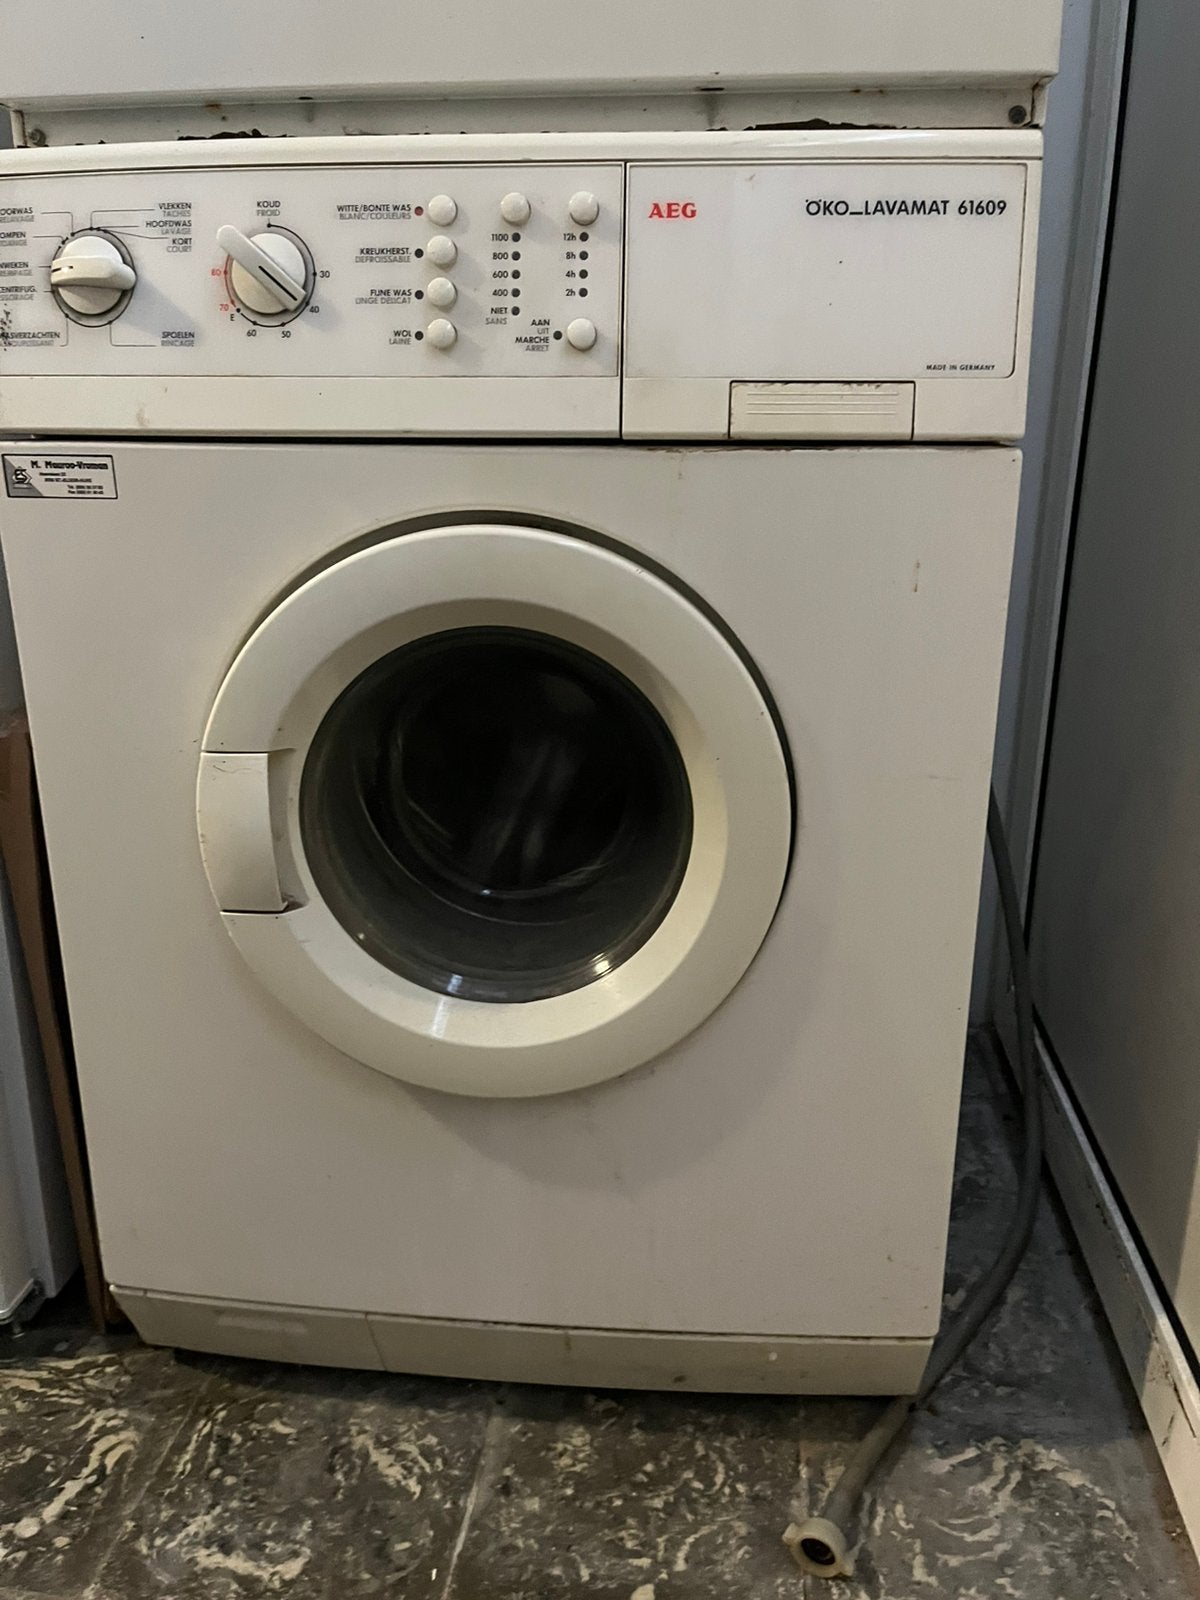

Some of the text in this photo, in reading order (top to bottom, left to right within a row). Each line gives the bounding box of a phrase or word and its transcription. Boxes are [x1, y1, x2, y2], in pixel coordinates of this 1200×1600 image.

[159, 202, 192, 210] VLEKKEN
[256, 200, 281, 208] KOUD
[336, 204, 411, 212] WITTE/BONTE WAS
[957, 199, 1007, 216] 61609
[0, 207, 33, 216] OORWAS
[256, 209, 280, 217] FROID
[648, 202, 697, 219] AEG
[339, 212, 411, 220] BLANC/COULEURS
[145, 220, 192, 228] HOOFDWAS
[491, 233, 509, 242] 1100
[563, 233, 577, 241] 12h
[172, 238, 192, 246] KORT
[492, 251, 509, 260] 800
[565, 251, 577, 260] 8h
[319, 270, 330, 278] 30
[492, 270, 509, 279] 600
[565, 270, 576, 278] 4h
[392, 288, 412, 297] WAS
[492, 288, 509, 297] 400
[565, 288, 576, 297] 2h
[380, 297, 411, 305] DELICAT
[219, 303, 230, 312] 70
[309, 305, 320, 313] 40
[490, 307, 508, 315] NIET
[230, 313, 235, 321] E
[485, 317, 508, 325] SANS
[530, 319, 551, 327] AAN
[161, 331, 195, 339] SPOELEN
[246, 329, 257, 337] 60
[281, 330, 291, 339] 50
[393, 329, 412, 338] WOL
[537, 327, 549, 335] UIT
[388, 338, 412, 346] LAINE
[514, 336, 550, 344] MARCHE
[525, 344, 549, 352] ARRET
